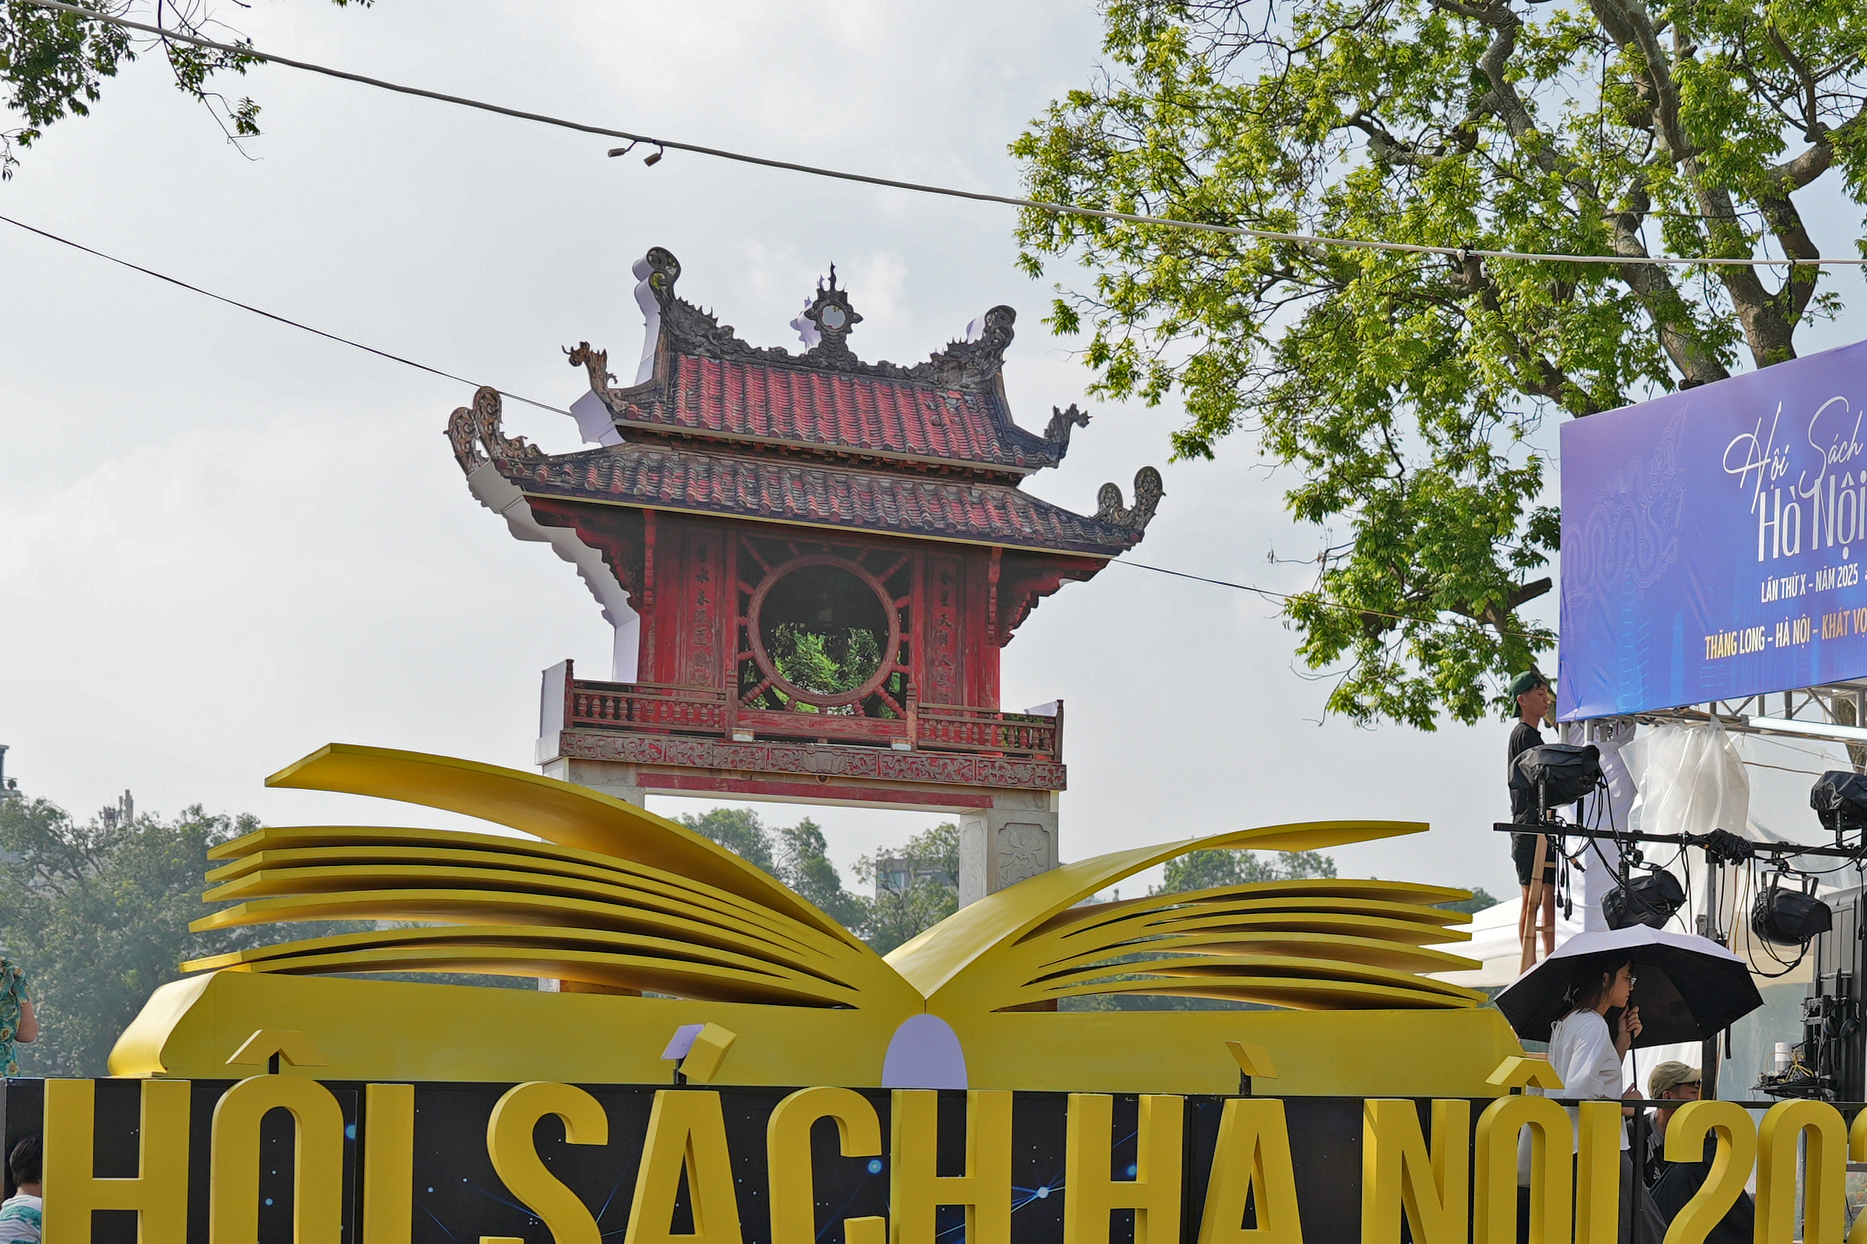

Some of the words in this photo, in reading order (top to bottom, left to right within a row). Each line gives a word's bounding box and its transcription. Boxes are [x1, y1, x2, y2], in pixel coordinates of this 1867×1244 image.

[1723, 400, 1790, 514] Hội
[1798, 396, 1864, 498] Sách
[1758, 484, 1801, 562] Hà
[1813, 470, 1867, 560] Nội
[1761, 575, 1778, 603] LẦN
[1780, 571, 1799, 600] THỨ
[1799, 574, 1807, 595] X
[1815, 566, 1835, 593] NĂM
[1837, 563, 1859, 588] 2025
[1705, 628, 1737, 660] THĂNG
[1739, 625, 1765, 654] LONG
[1775, 616, 1790, 648] HÀ
[1793, 613, 1811, 649] NỘI
[1821, 607, 1851, 641] KHÁT
